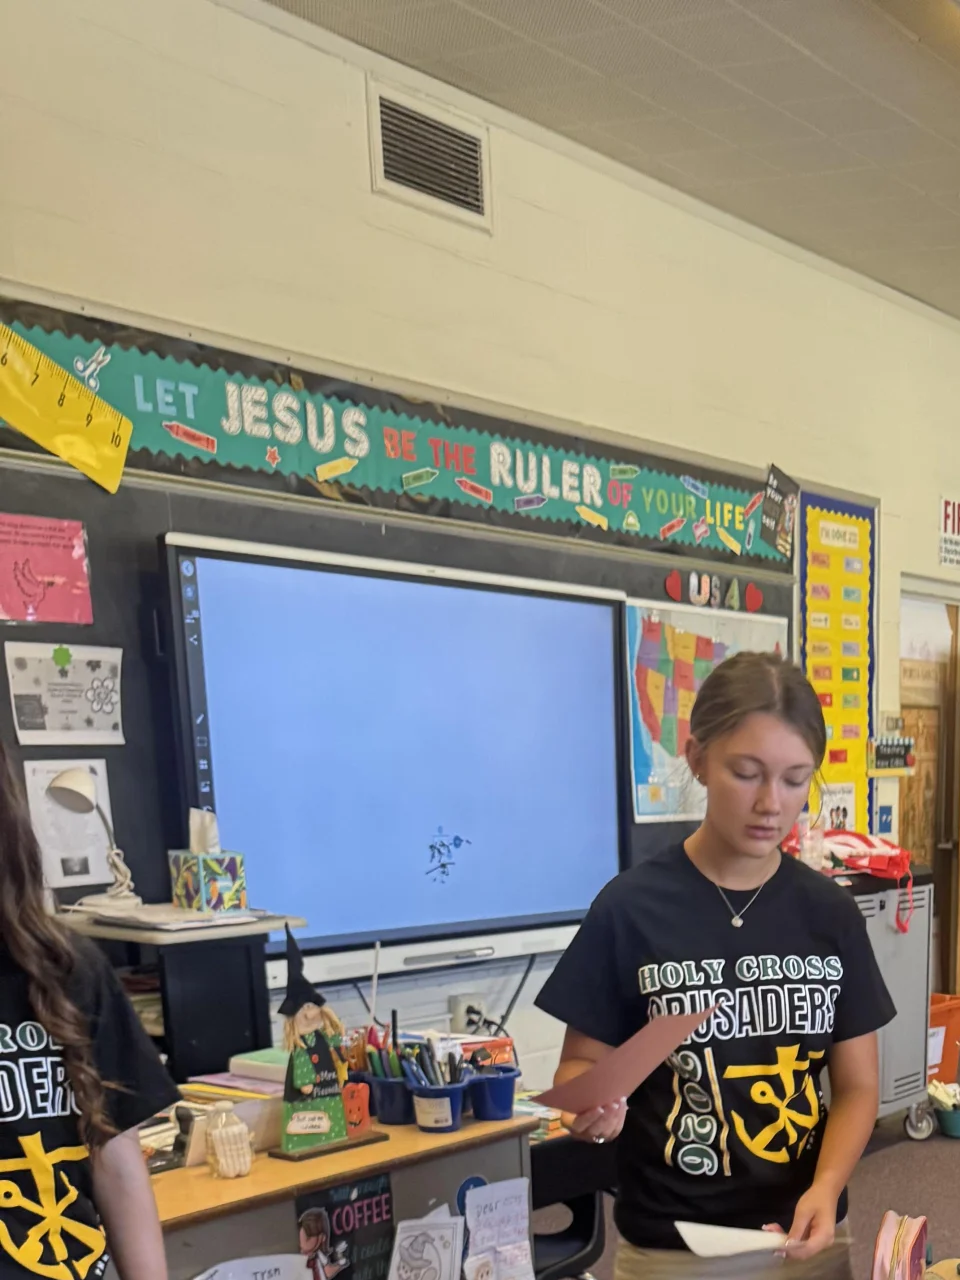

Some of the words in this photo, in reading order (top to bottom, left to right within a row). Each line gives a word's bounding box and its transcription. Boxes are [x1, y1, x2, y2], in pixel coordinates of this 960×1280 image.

[1, 353, 7, 366] 6
[31, 373, 39, 386] 7
[58, 394, 65, 407] 8
[86, 414, 92, 427] 9
[111, 432, 121, 448] 10
[133, 374, 199, 420] LET
[220, 381, 370, 458] JESUS
[382, 427, 417, 461] BE
[428, 438, 476, 475] THE
[490, 442, 603, 507] RULER
[608, 479, 633, 508] OF
[641, 486, 696, 519] YOUR
[705, 499, 745, 531] LIFE
[689, 571, 740, 611] USA
[639, 959, 725, 994] HOLY
[735, 955, 844, 981] CROSS
[648, 984, 841, 1045] CRUSADERS
[668, 1050, 718, 1176] 2026
[332, 1193, 391, 1235] COFFEE
